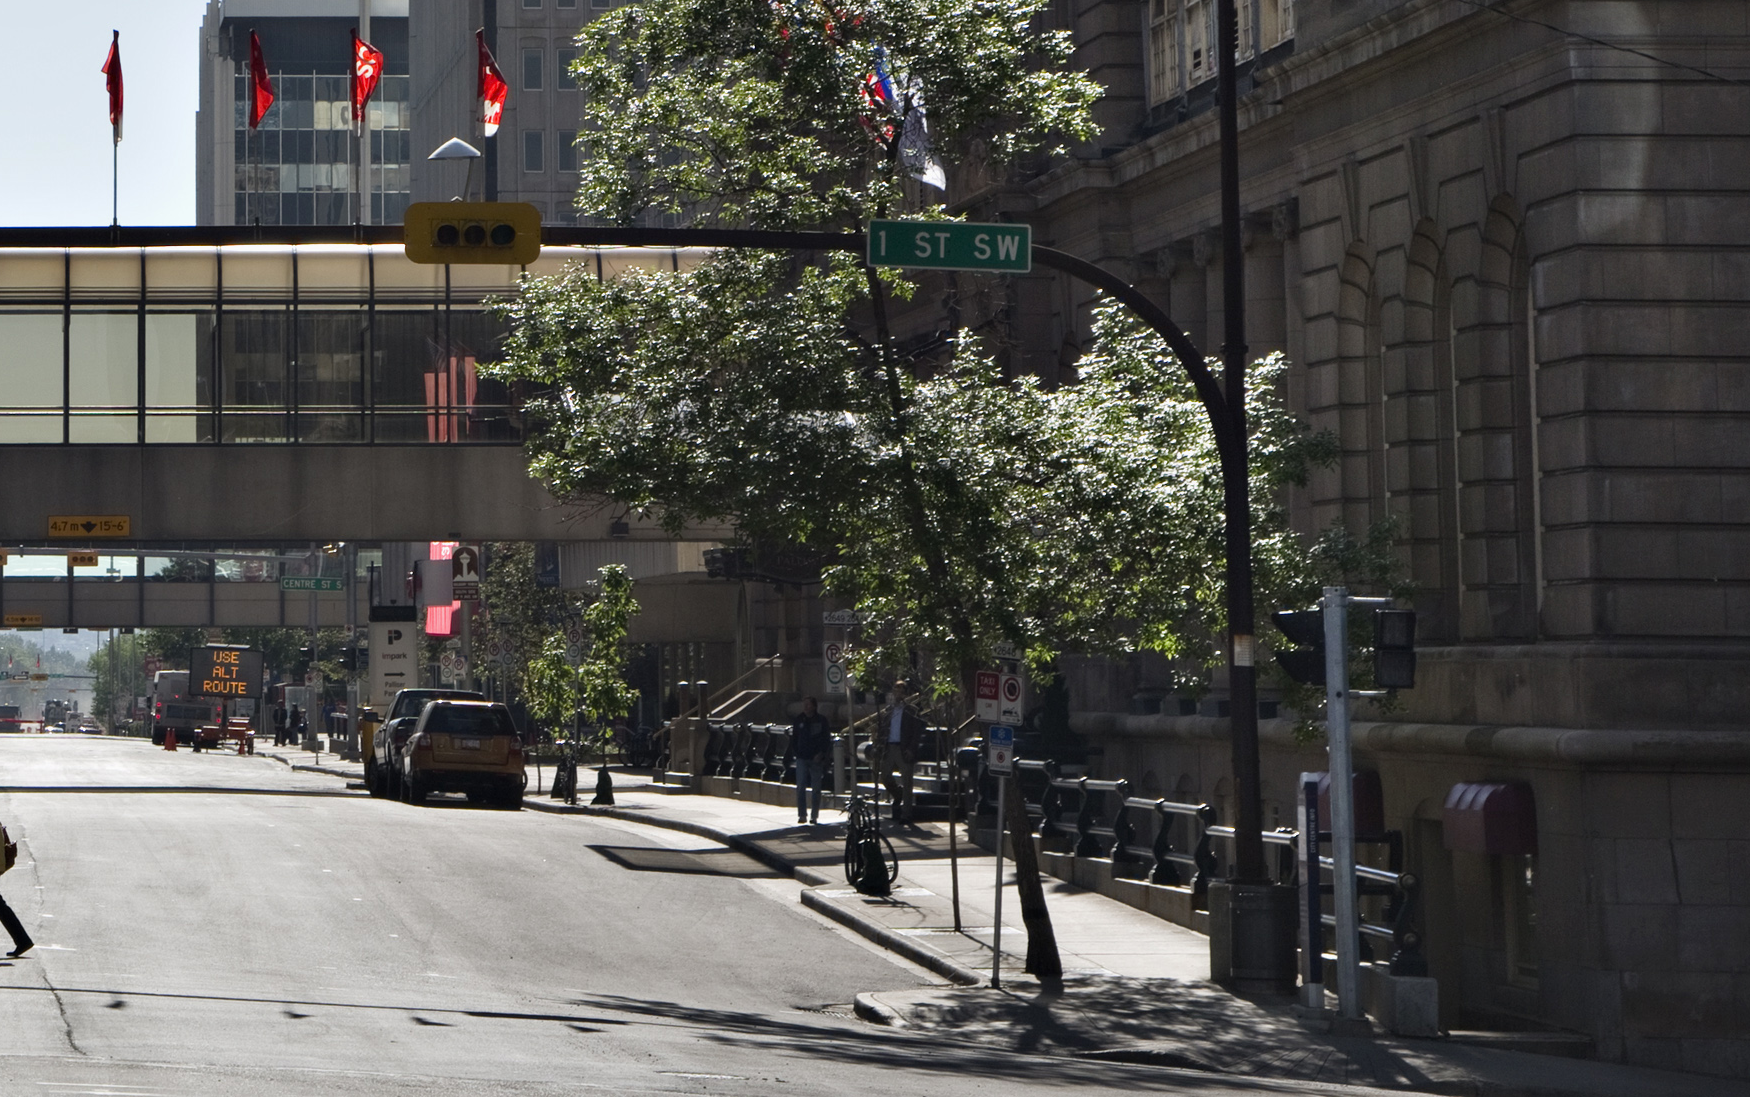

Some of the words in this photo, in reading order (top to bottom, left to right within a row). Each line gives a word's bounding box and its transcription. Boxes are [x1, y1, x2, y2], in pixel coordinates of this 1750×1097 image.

[878, 230, 886, 256] 1
[914, 231, 950, 258] ST
[974, 233, 1019, 261] SW
[283, 579, 316, 589] CENTRE
[321, 580, 331, 589] ST
[336, 581, 342, 589] S
[213, 650, 240, 663] USE
[212, 666, 239, 678] ALT
[203, 680, 247, 694] ROUTE
[980, 676, 996, 686] TAXI
[979, 686, 996, 696] ONLY
